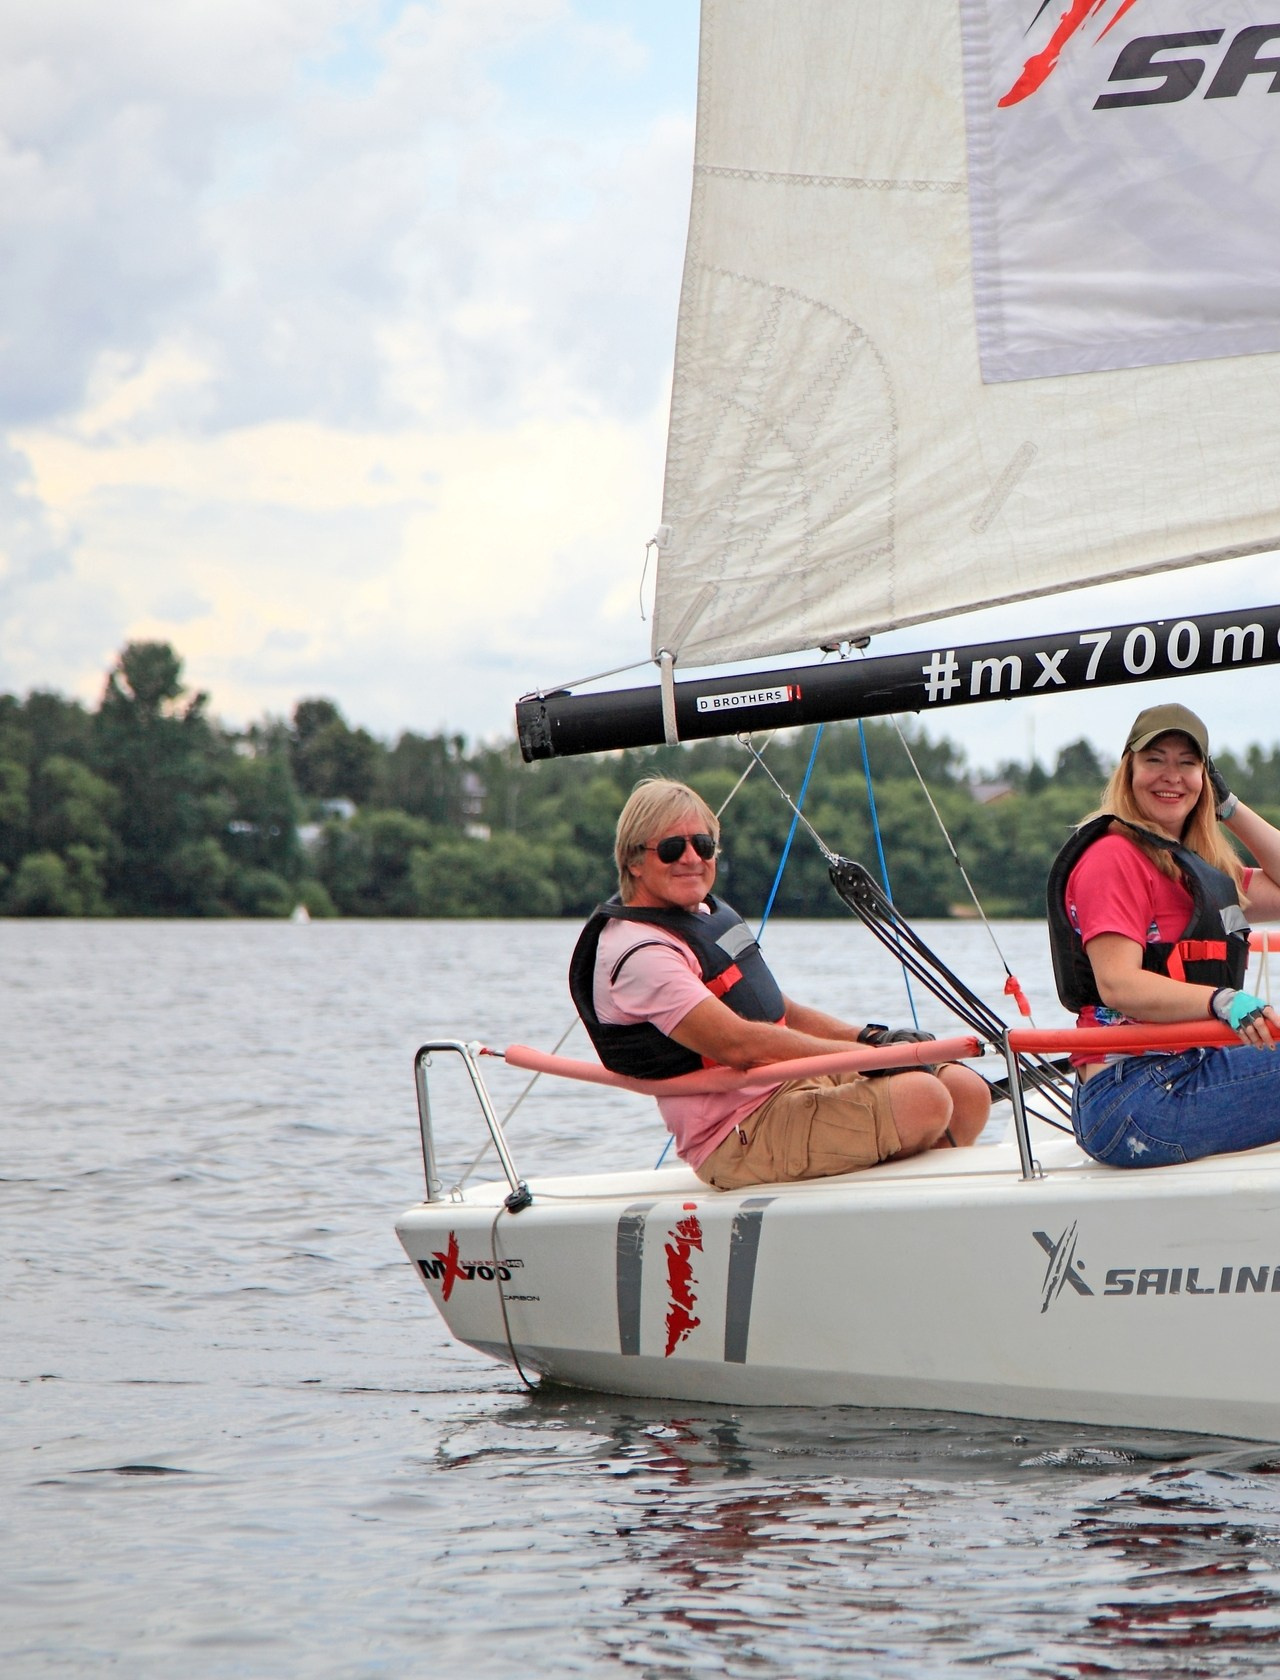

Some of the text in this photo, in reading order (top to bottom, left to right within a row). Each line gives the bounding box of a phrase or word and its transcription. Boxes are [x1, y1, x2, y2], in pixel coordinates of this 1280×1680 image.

[700, 690, 782, 709] D BROTHERS
[417, 1230, 511, 1302] MX700
